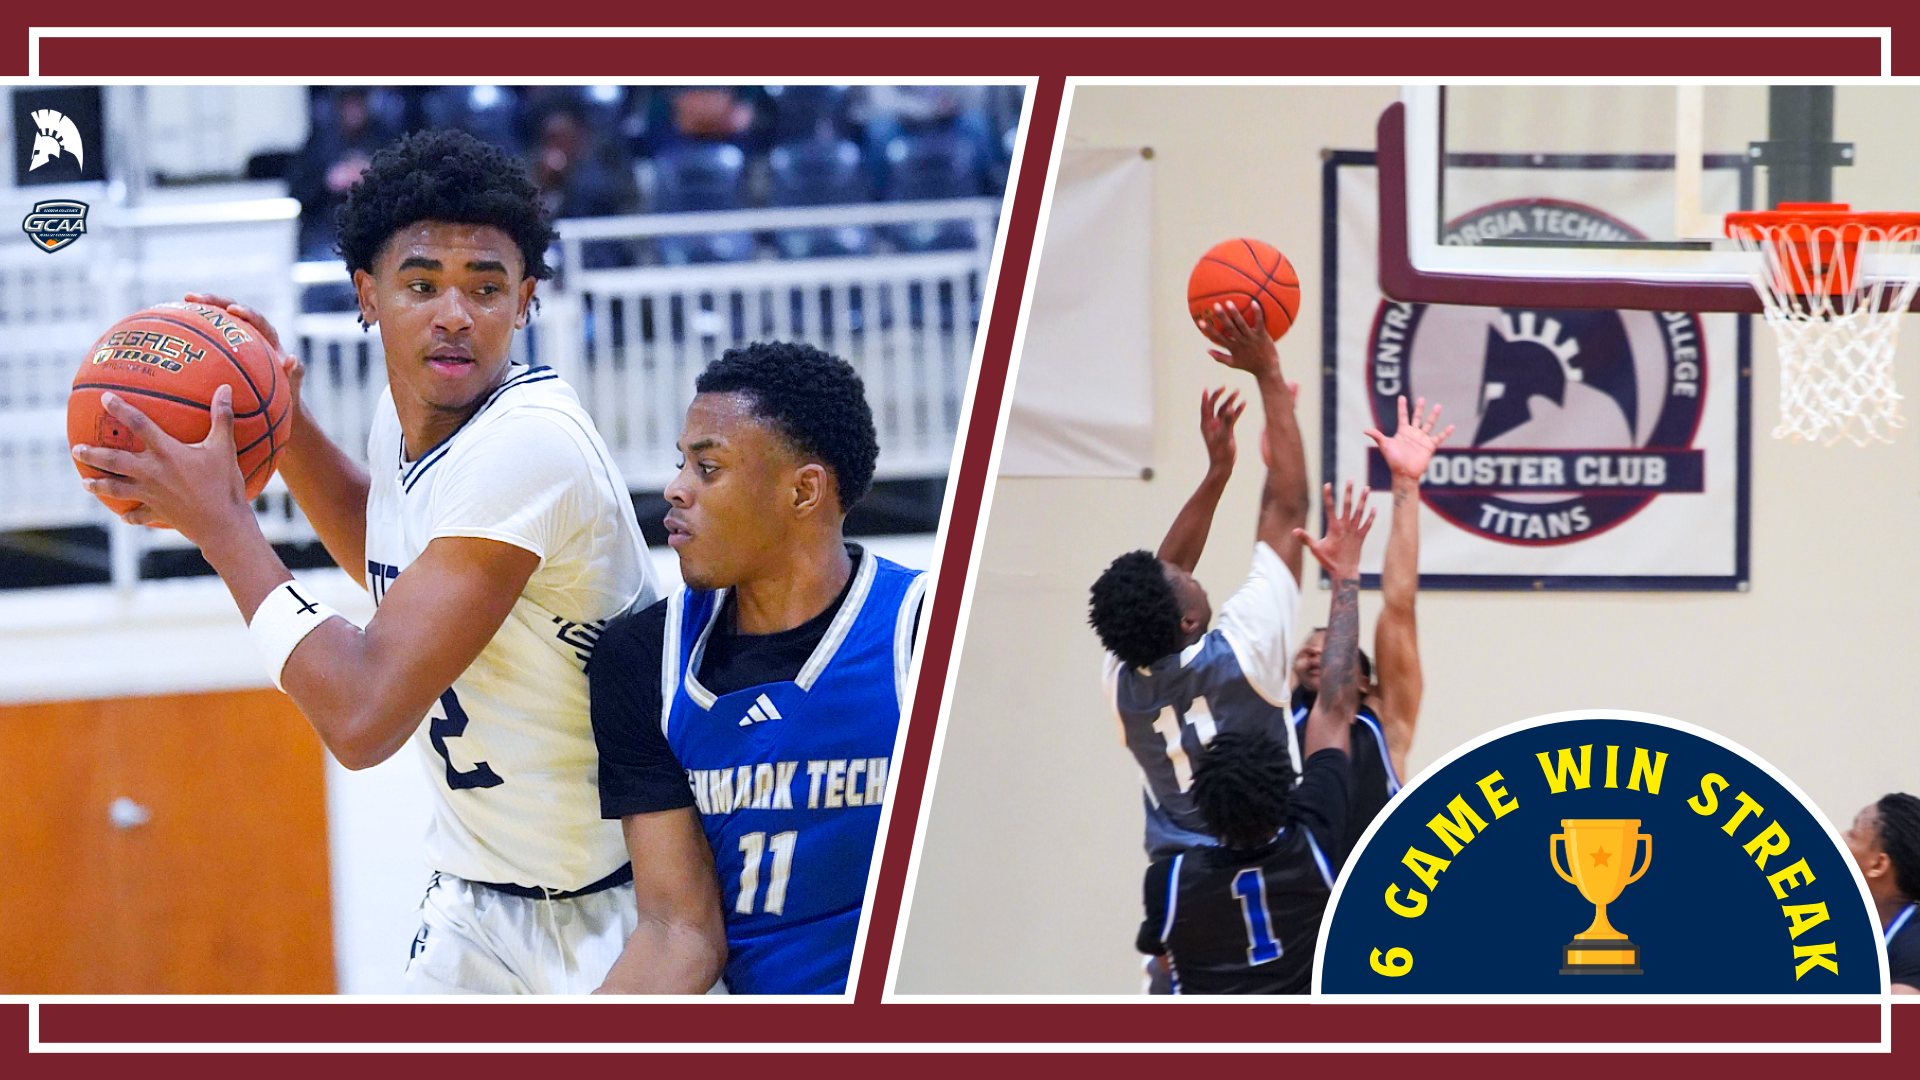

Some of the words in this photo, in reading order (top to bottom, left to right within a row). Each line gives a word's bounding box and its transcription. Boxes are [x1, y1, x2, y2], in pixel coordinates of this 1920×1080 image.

[1443, 209, 1526, 245] ORGIA
[1419, 455, 1565, 486] OOSTER
[1575, 456, 1667, 486] CLUB
[1479, 503, 1592, 539] TITANS
[429, 686, 505, 790] 2
[807, 757, 889, 810] TECH
[735, 831, 798, 916] 11
[1231, 867, 1284, 967] 1
